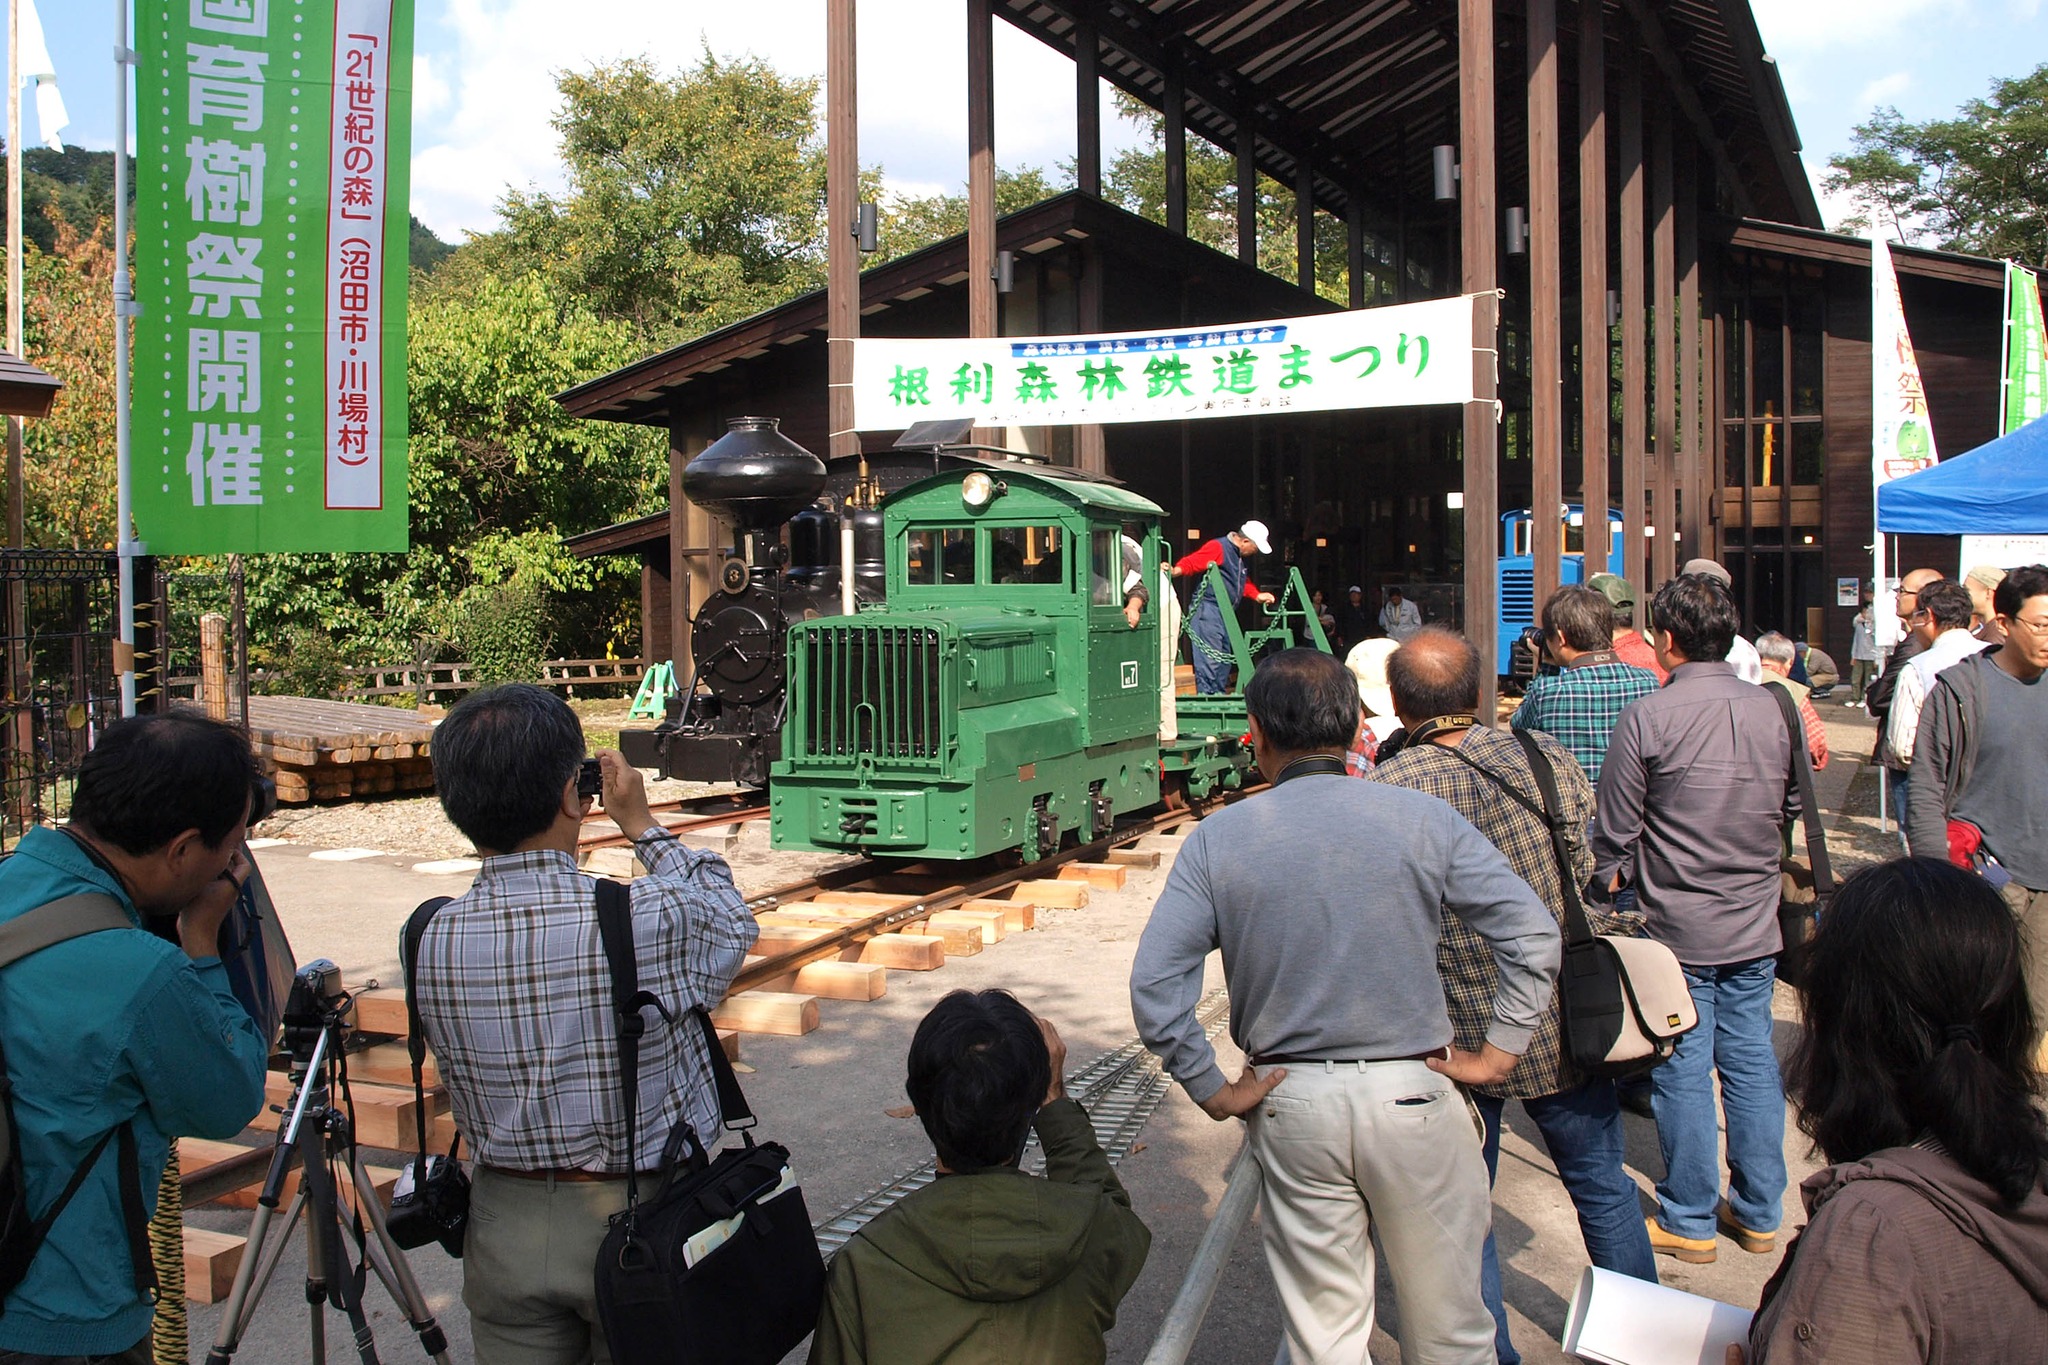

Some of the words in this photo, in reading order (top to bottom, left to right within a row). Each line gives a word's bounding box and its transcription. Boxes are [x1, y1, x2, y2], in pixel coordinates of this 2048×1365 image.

[888, 333, 1431, 407] 根利森林鉄道まつり
